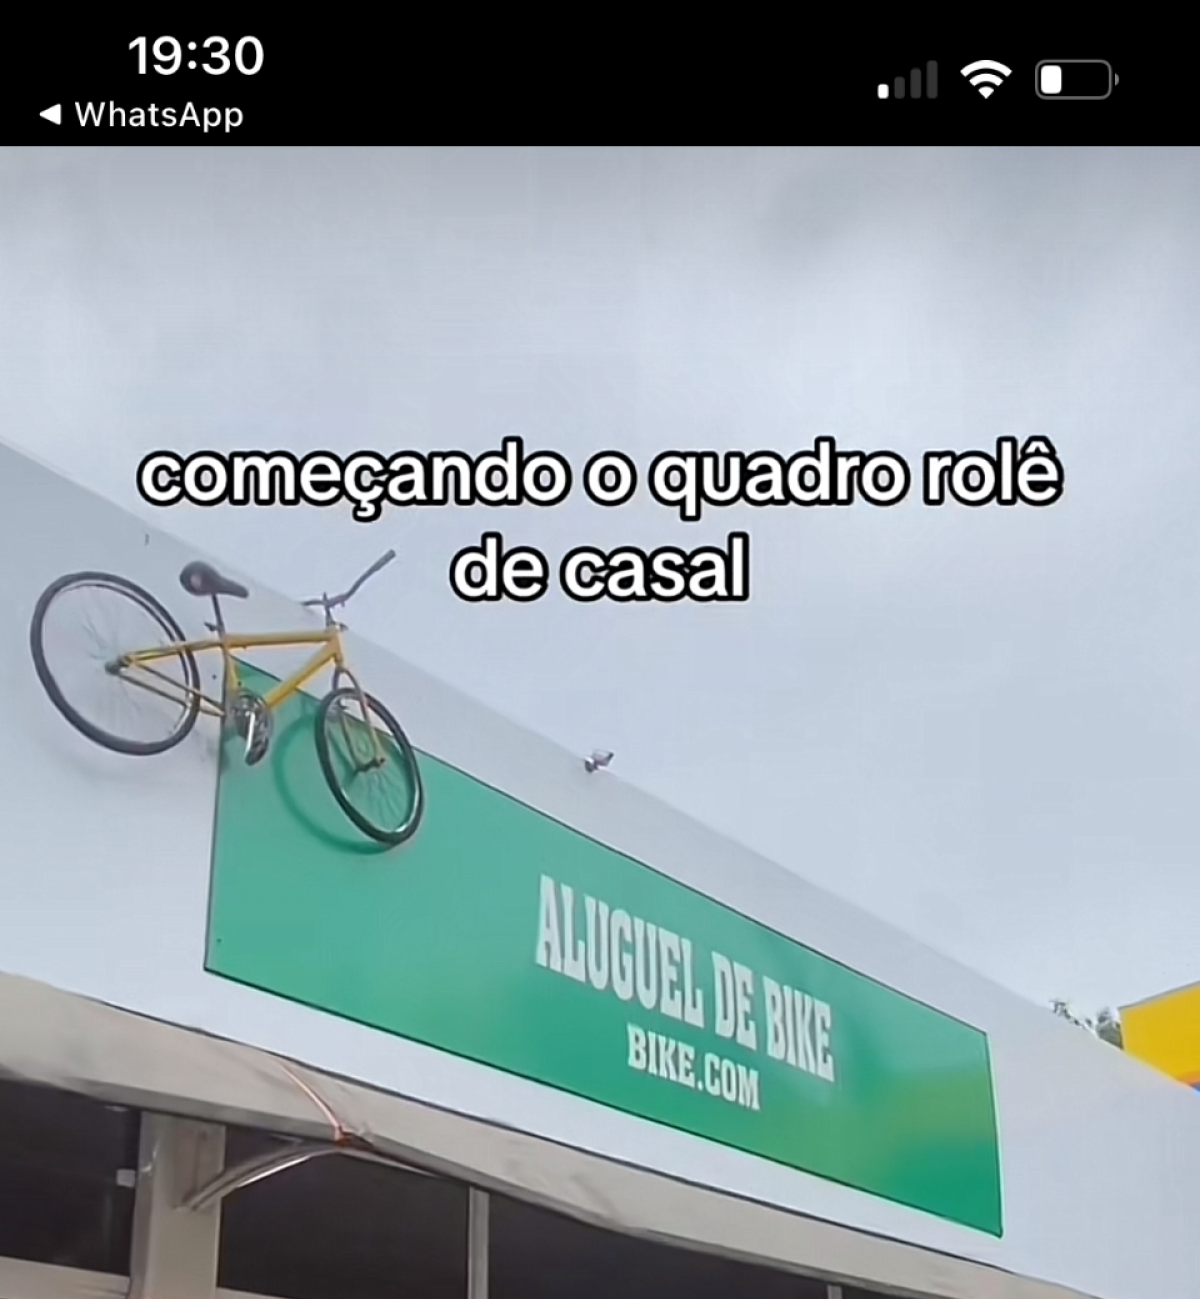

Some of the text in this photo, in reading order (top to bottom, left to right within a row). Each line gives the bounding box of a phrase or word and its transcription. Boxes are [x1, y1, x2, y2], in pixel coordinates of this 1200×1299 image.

[536, 873, 835, 1082] ALUGUEL DE BIKE
[626, 1022, 760, 1111] BIKE.COM
